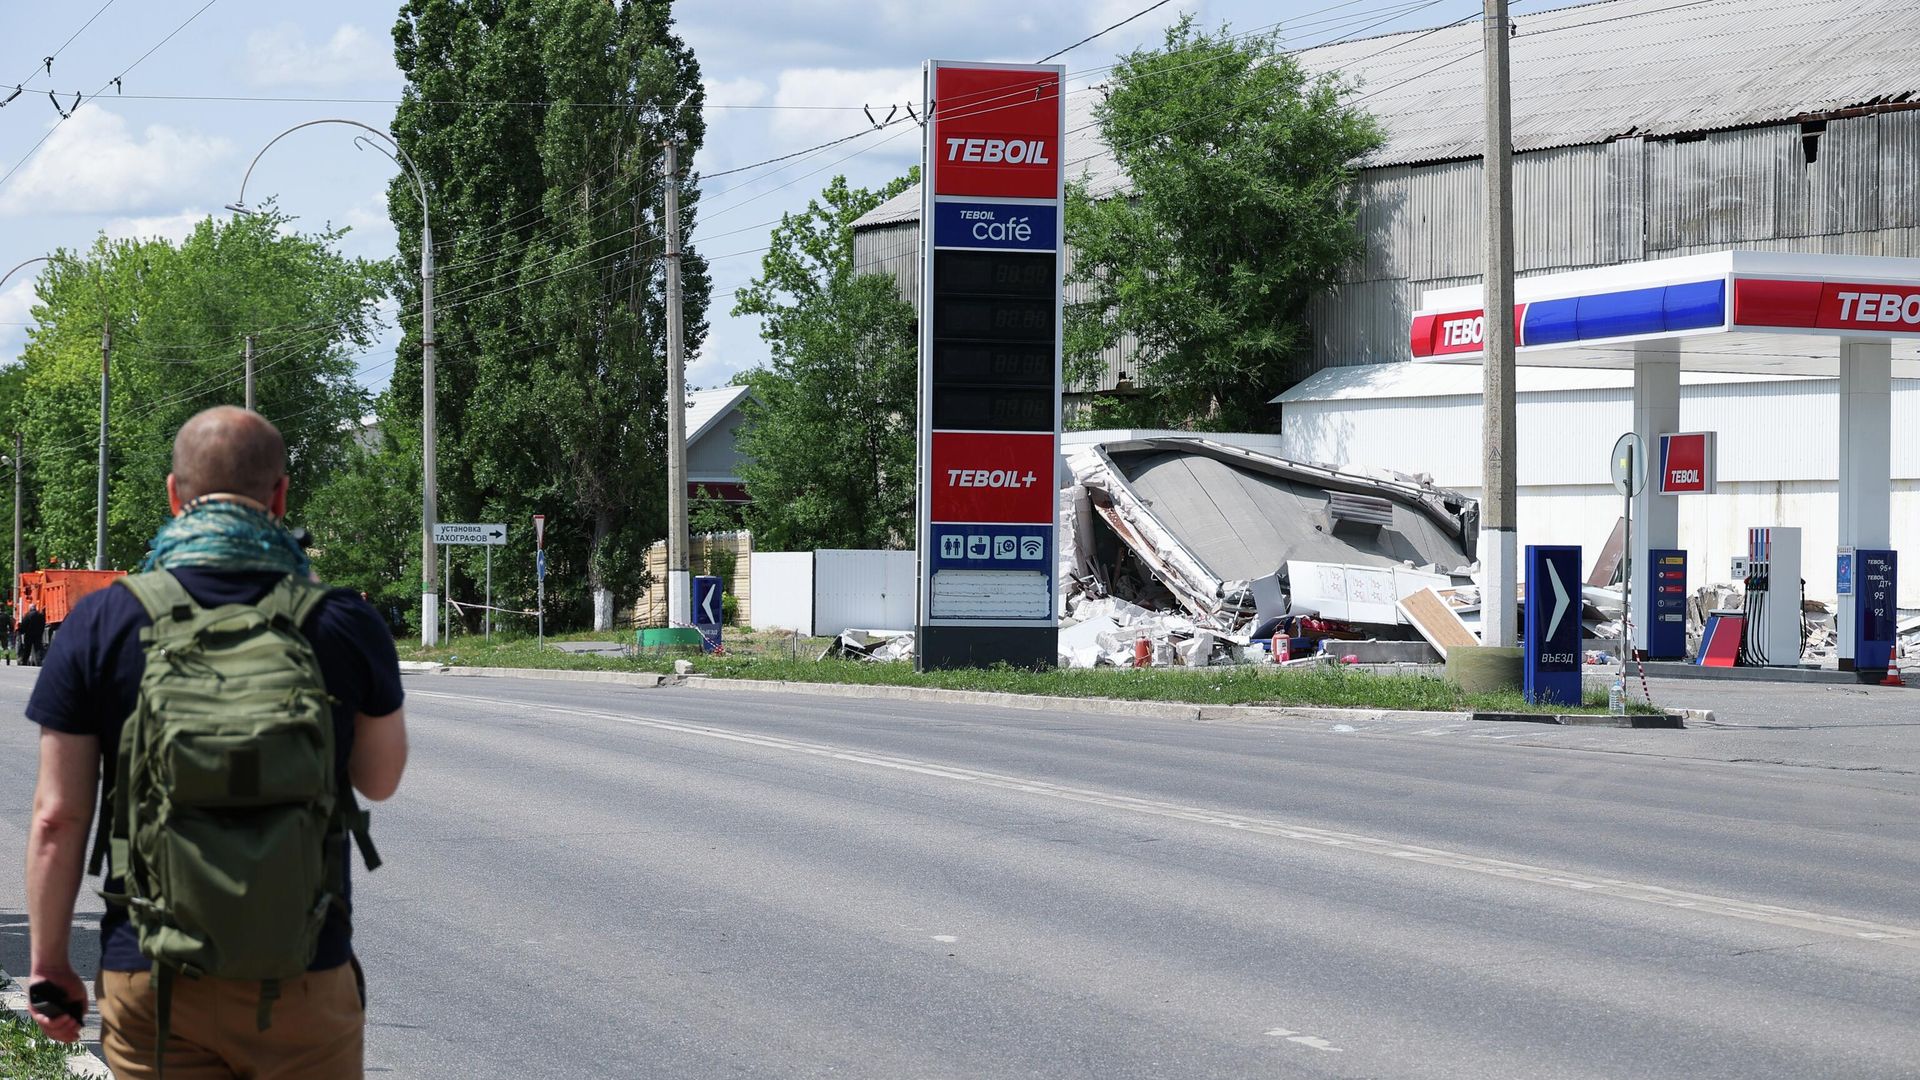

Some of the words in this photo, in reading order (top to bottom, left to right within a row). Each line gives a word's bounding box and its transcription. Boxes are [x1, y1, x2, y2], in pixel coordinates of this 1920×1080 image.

[946, 138, 1049, 164] TEBOIL
[960, 210, 995, 220] TEBOIL
[972, 217, 1032, 242] café
[947, 469, 1037, 488] TEBOIL+
[1671, 469, 1700, 484] TEBOIL
[441, 526, 481, 534] установка
[1874, 592, 1884, 600] 95
[1874, 608, 1884, 616] 92
[1542, 653, 1574, 664] ВЪЕЗД
